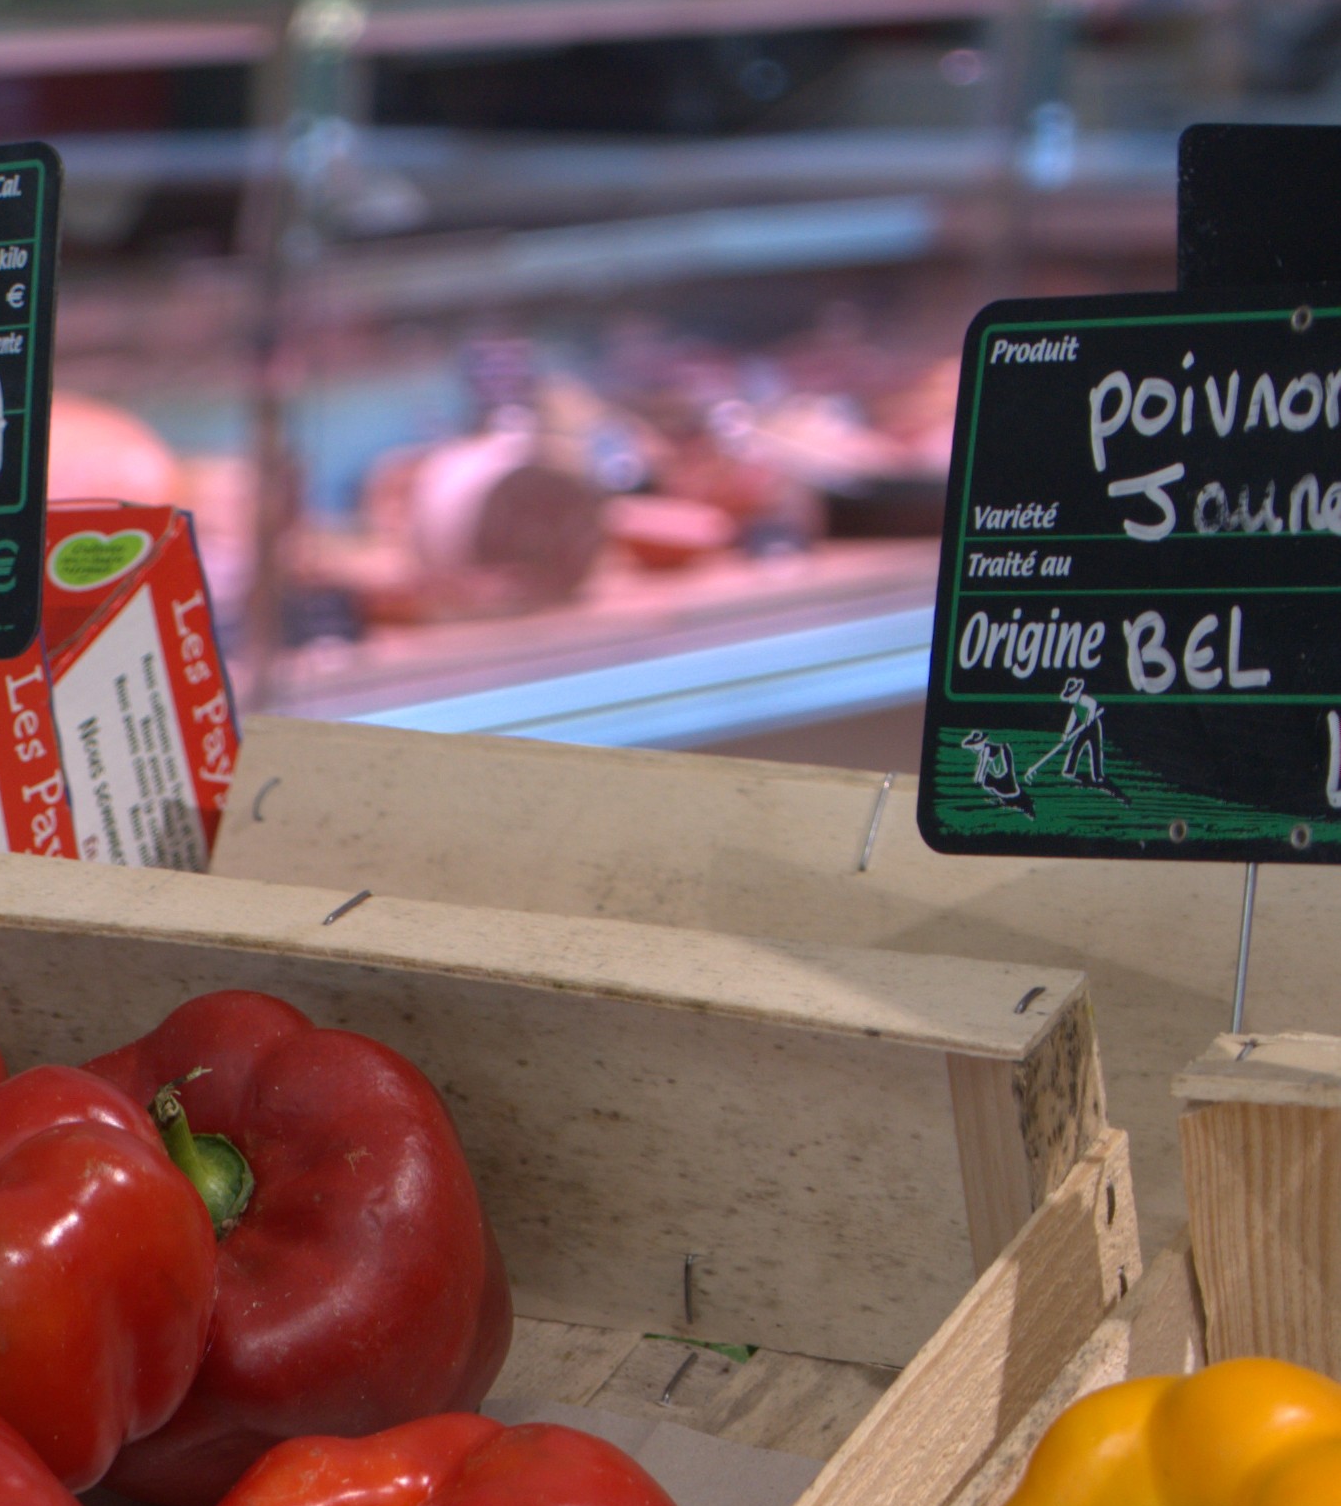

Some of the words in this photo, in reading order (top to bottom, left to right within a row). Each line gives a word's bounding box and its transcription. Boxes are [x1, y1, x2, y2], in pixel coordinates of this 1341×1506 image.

[5, 283, 26, 309] €
[990, 335, 1079, 364] Produit
[973, 501, 1060, 531] Variété
[968, 550, 1036, 580] Traité
[1040, 554, 1072, 578] au
[172, 590, 212, 685] Les
[959, 607, 1106, 680] Origine
[1123, 604, 1271, 694] BEL
[6, 665, 46, 762] Les
[78, 715, 105, 780] Nous
